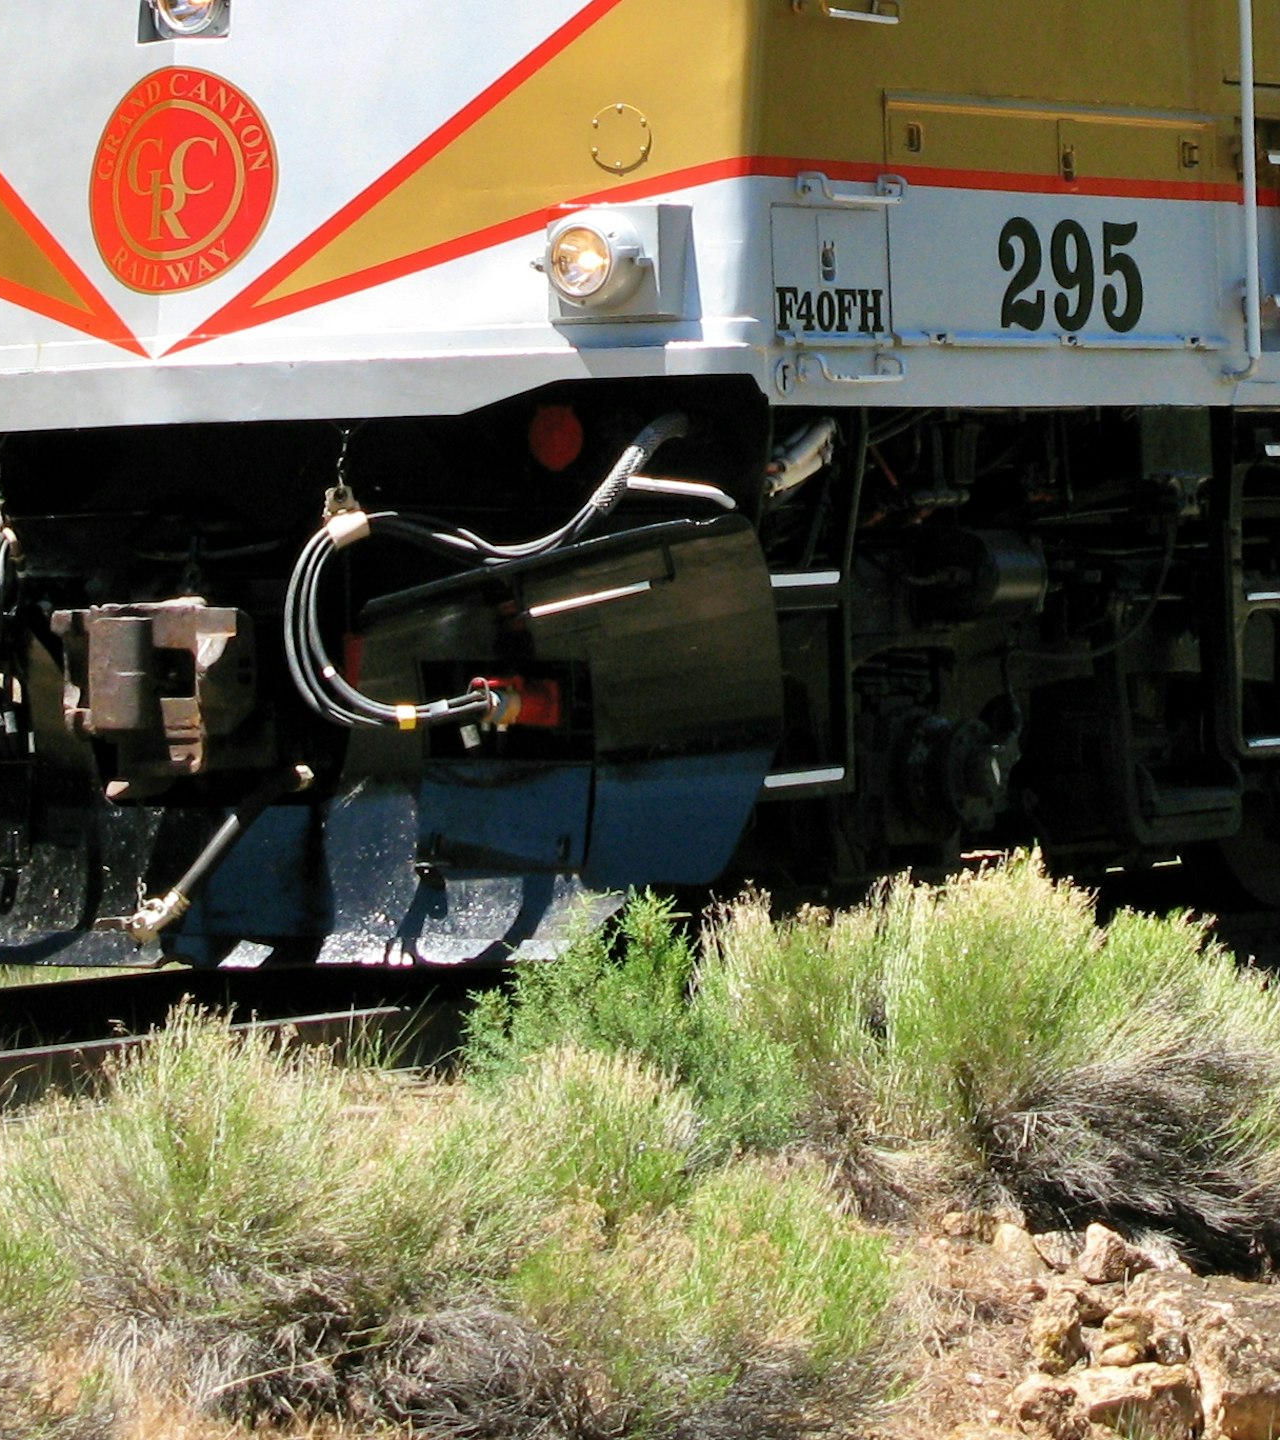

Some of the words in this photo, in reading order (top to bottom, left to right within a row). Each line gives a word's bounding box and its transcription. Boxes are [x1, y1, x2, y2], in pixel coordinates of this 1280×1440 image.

[97, 80, 162, 180] GRAND
[170, 74, 270, 172] CANYON
[113, 240, 231, 288] RAILWAY
[998, 216, 1144, 333] 295
[775, 286, 884, 333] F40FH
[781, 364, 789, 391] F
